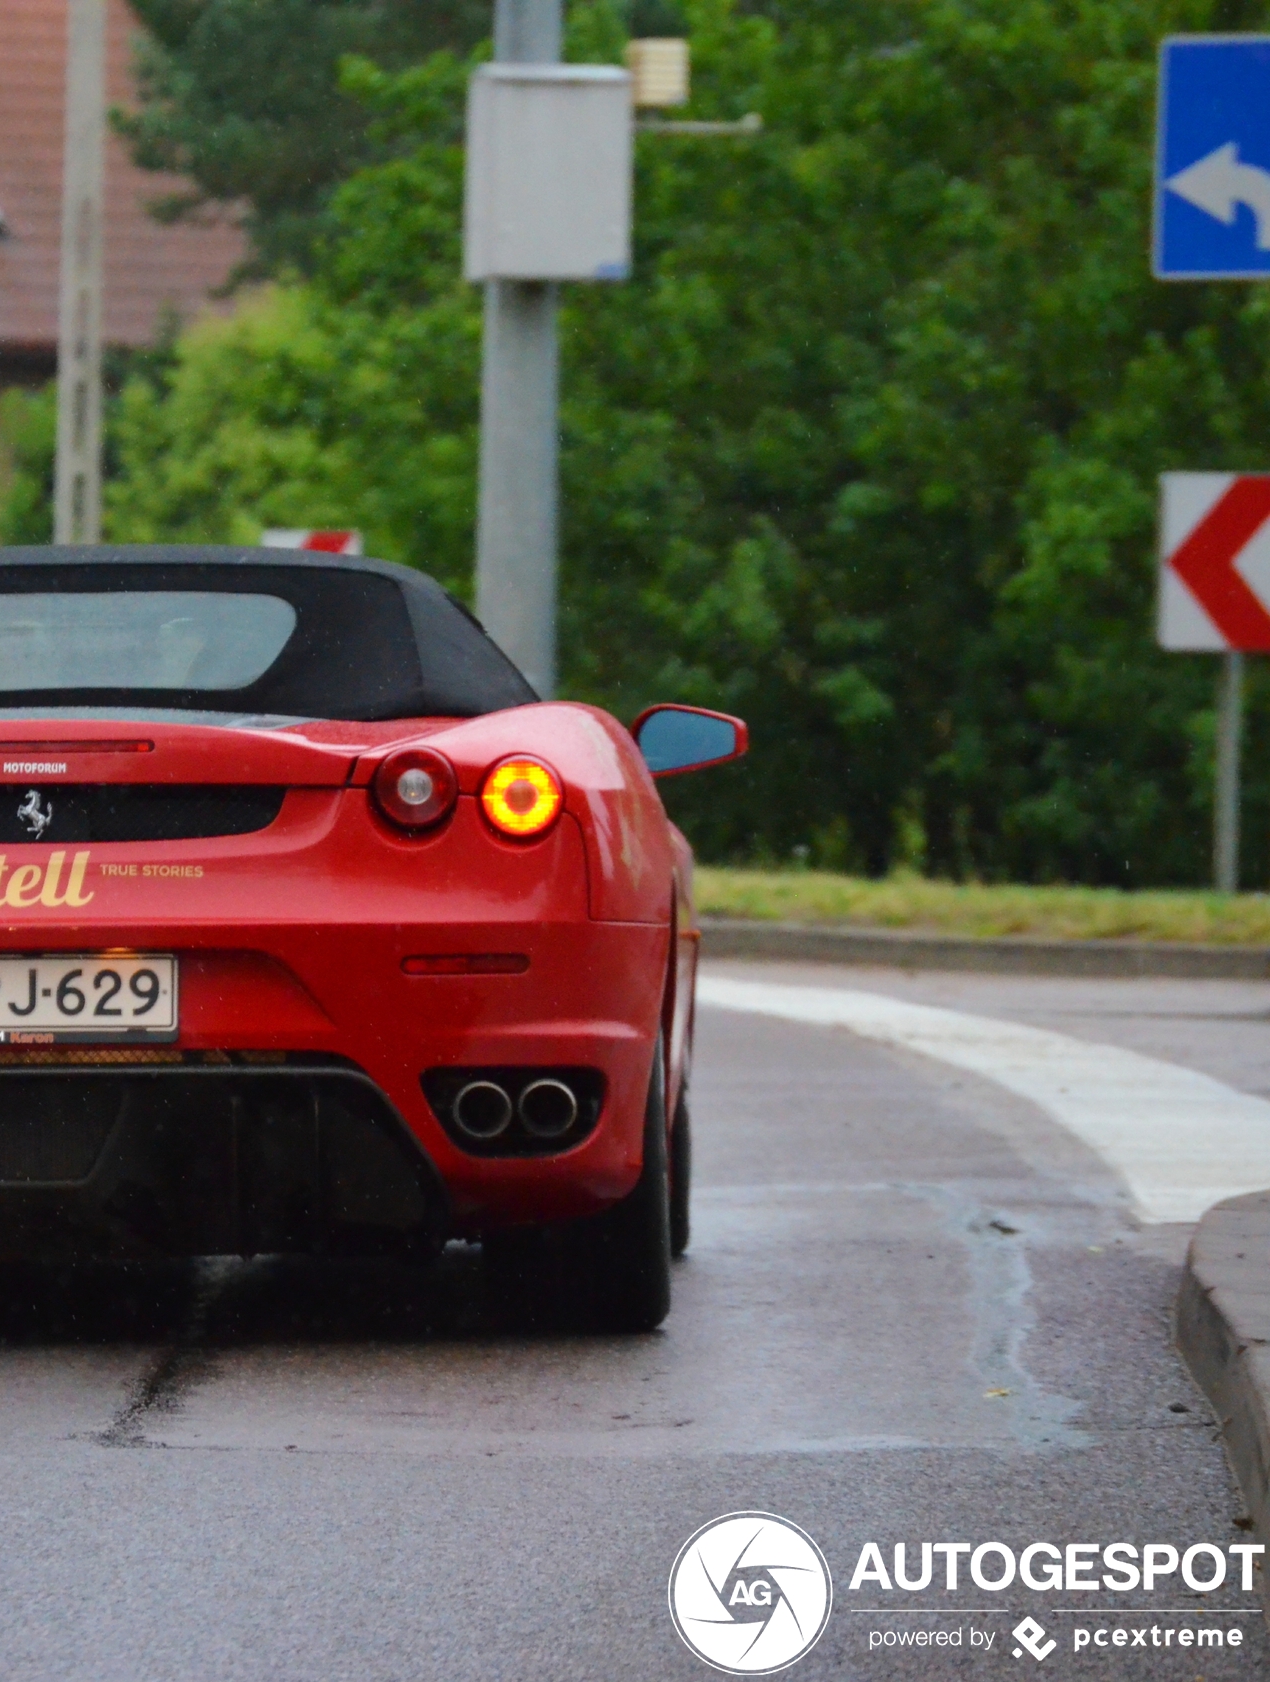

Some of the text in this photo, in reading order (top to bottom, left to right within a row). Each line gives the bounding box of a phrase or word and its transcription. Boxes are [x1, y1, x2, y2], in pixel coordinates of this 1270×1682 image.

[3, 762, 67, 774] MOTOFORUM
[99, 864, 204, 878] TRUE STORIES
